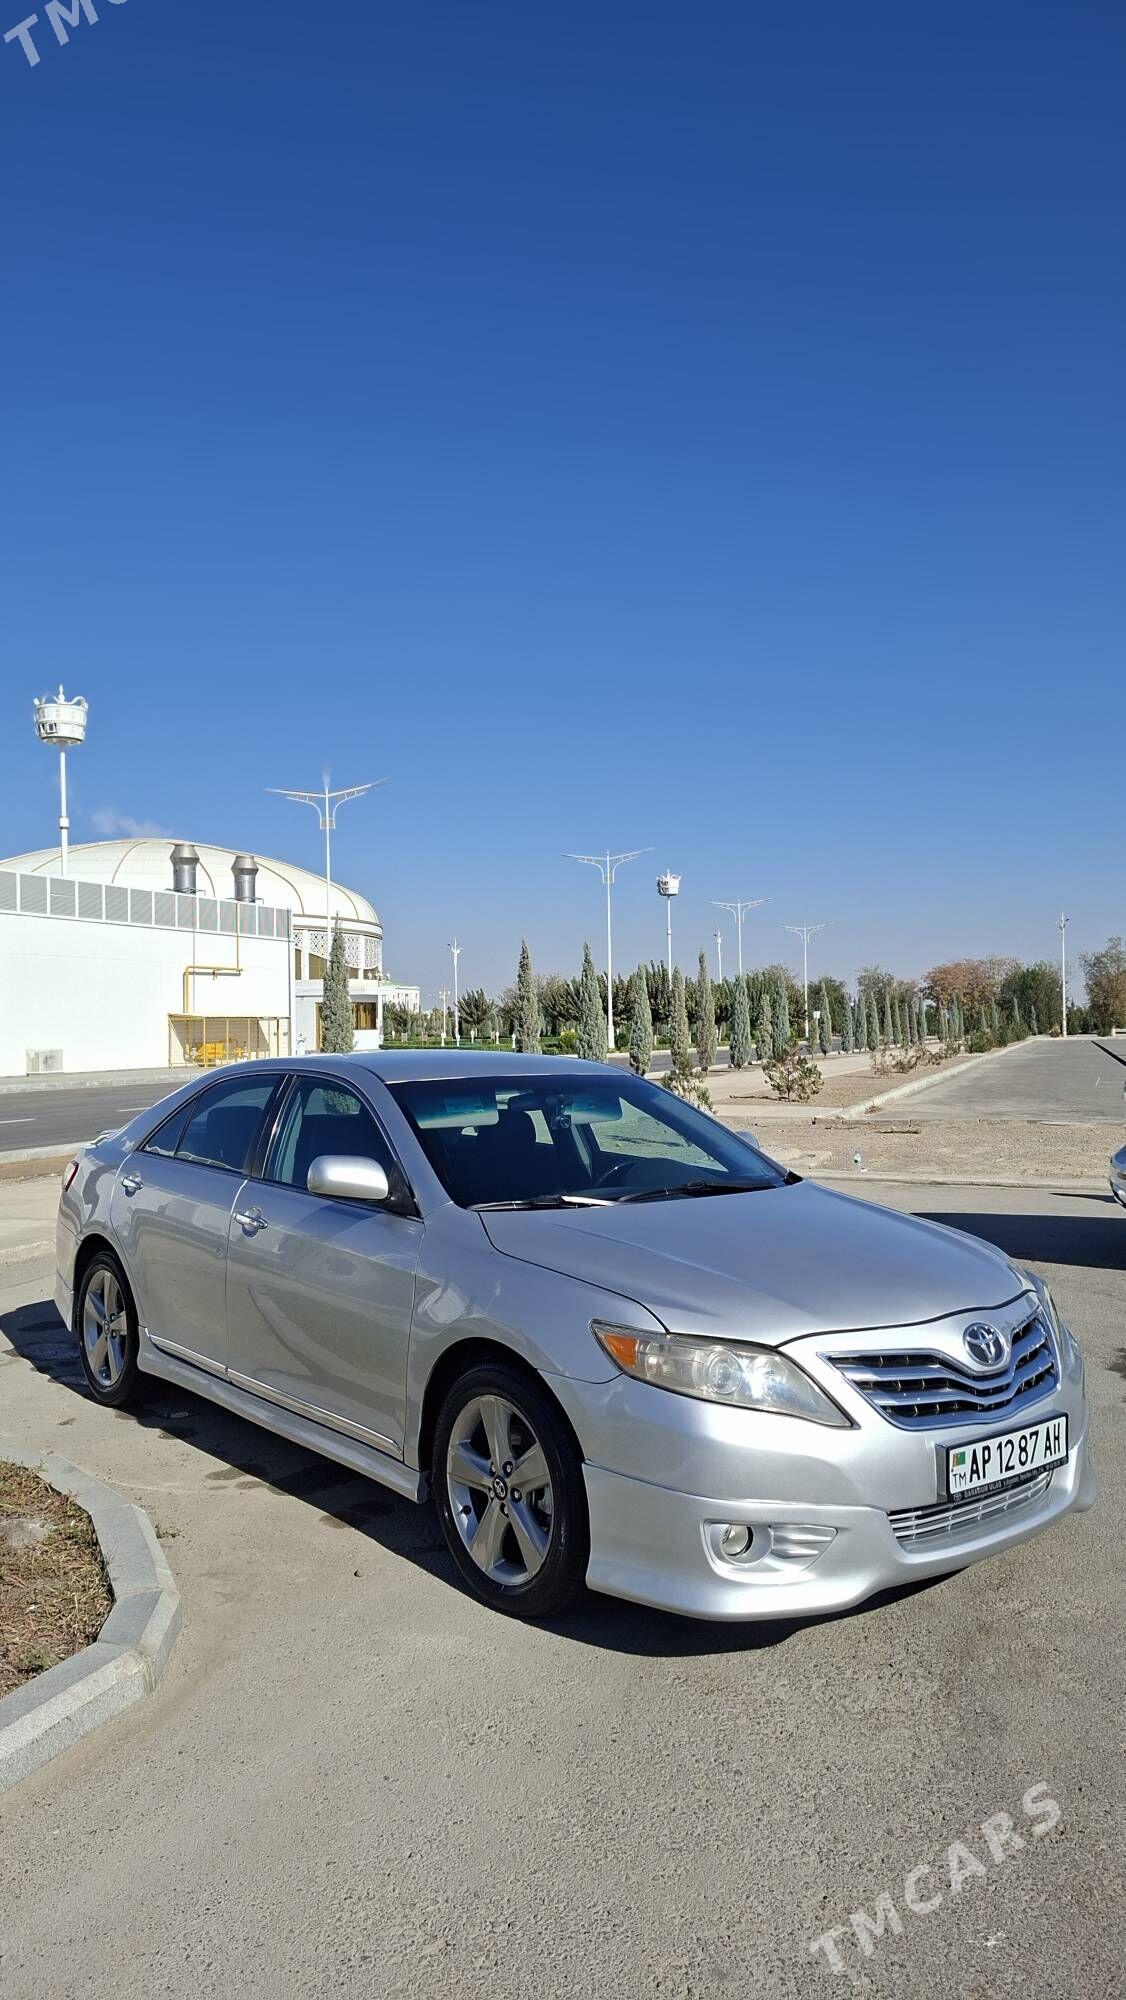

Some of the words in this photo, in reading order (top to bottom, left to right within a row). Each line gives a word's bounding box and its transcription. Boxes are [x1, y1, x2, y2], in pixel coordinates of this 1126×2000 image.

[970, 1445, 991, 1483] AP
[997, 1430, 1040, 1474] 1287
[1044, 1422, 1061, 1458] AH
[952, 1471, 967, 1489] TM
